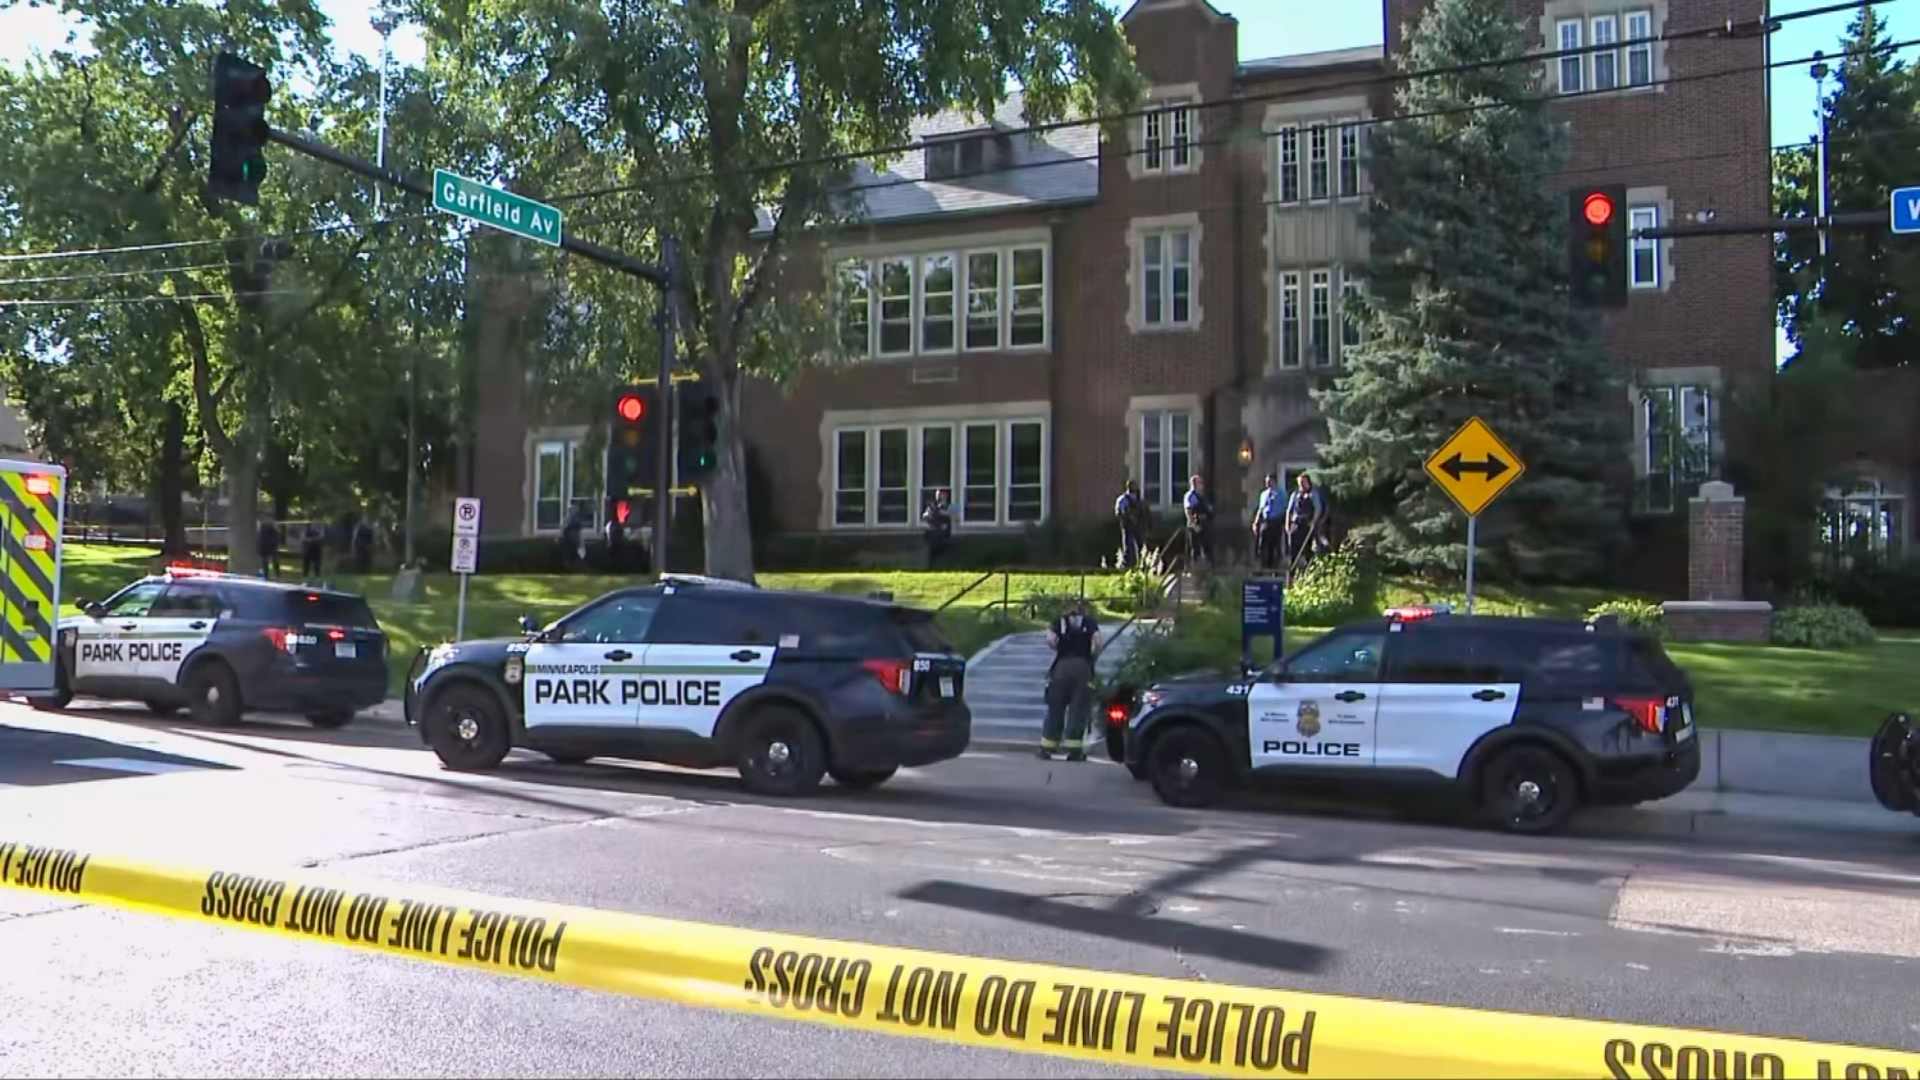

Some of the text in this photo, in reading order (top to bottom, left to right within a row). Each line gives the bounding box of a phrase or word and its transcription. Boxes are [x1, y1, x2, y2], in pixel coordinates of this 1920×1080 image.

[443, 181, 554, 235] Garfield Av
[82, 643, 182, 661] PARK POLICE
[536, 664, 599, 675] MINNEAPOLIS
[535, 679, 721, 706] PARK POLICE
[1226, 685, 1248, 695] 431
[1263, 740, 1361, 757] POLICE
[15, 845, 90, 894] POLICE
[201, 870, 567, 972] POLICE LINE DO NOT CROSS
[744, 947, 1316, 1075] POLICE LINE DO NOT CROSS
